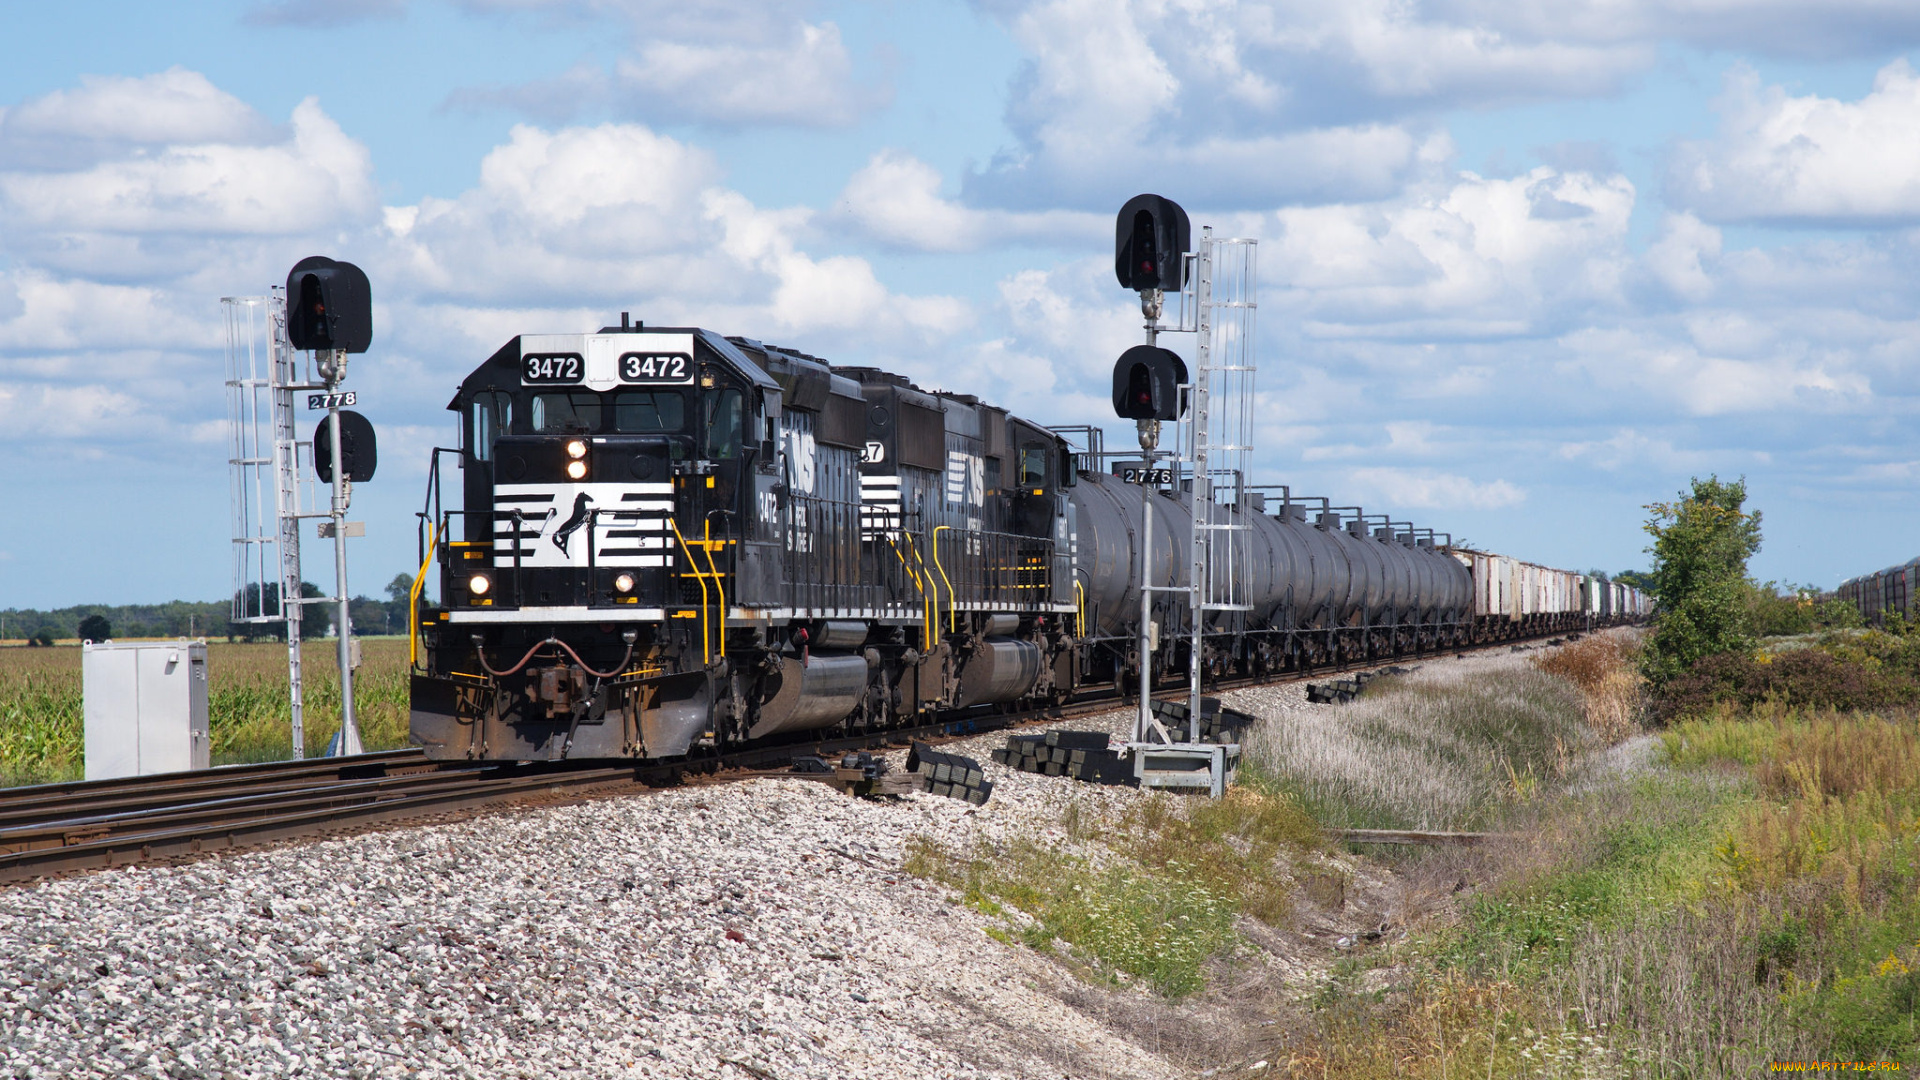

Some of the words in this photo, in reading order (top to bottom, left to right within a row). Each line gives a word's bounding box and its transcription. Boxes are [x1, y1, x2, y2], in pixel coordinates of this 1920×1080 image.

[528, 357, 579, 379] 3472
[626, 356, 685, 378] 3472
[309, 392, 356, 409] 2778
[1125, 469, 1171, 483] 2776
[759, 491, 777, 524] 3472
